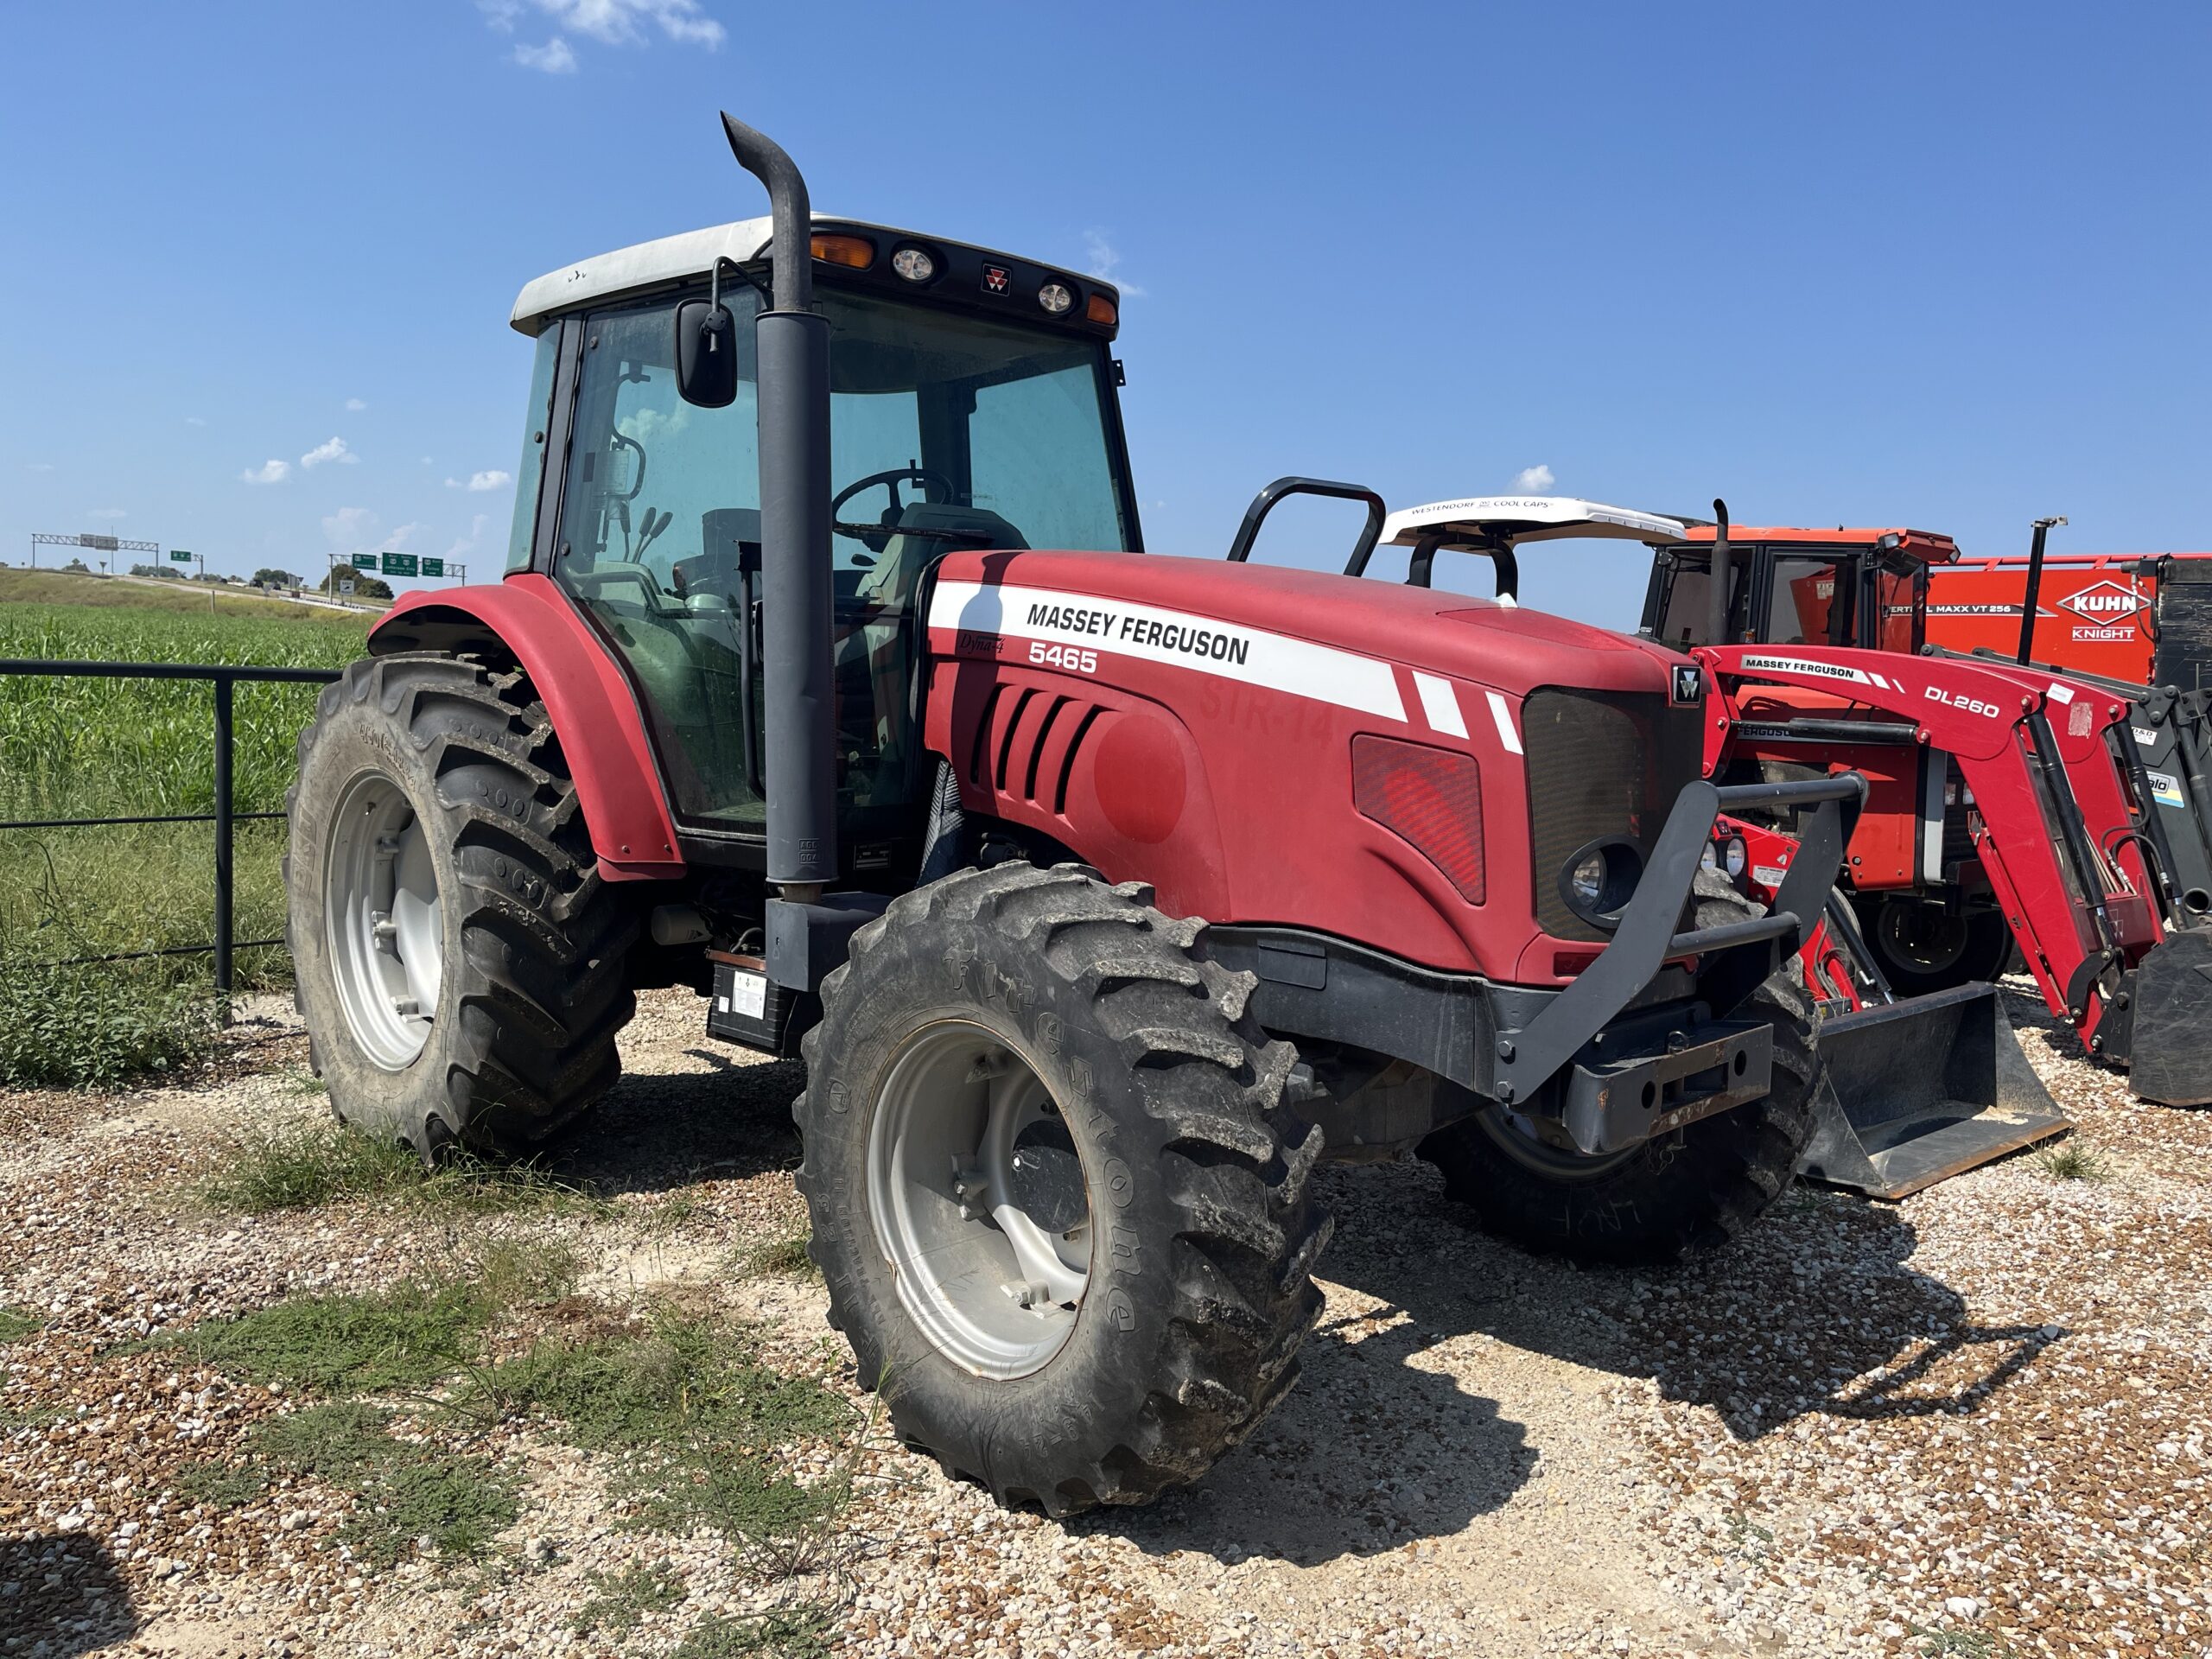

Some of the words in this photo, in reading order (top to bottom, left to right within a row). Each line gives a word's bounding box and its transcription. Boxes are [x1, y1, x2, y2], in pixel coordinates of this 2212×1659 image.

[1412, 501, 1476, 515] WESTENDORF
[2074, 595, 2138, 612] KUHN
[959, 633, 1007, 654] Dyna-4
[1027, 603, 1117, 638] MASSEY
[1120, 616, 1249, 666] FERGUSON
[2072, 629, 2135, 639] KNIGHT
[1028, 641, 1098, 674] 5465
[1745, 659, 1791, 670] MASSEY
[1794, 663, 1854, 679] FERGUSON
[1924, 686, 1999, 718] DL260
[944, 945, 1142, 1336] Firestone
